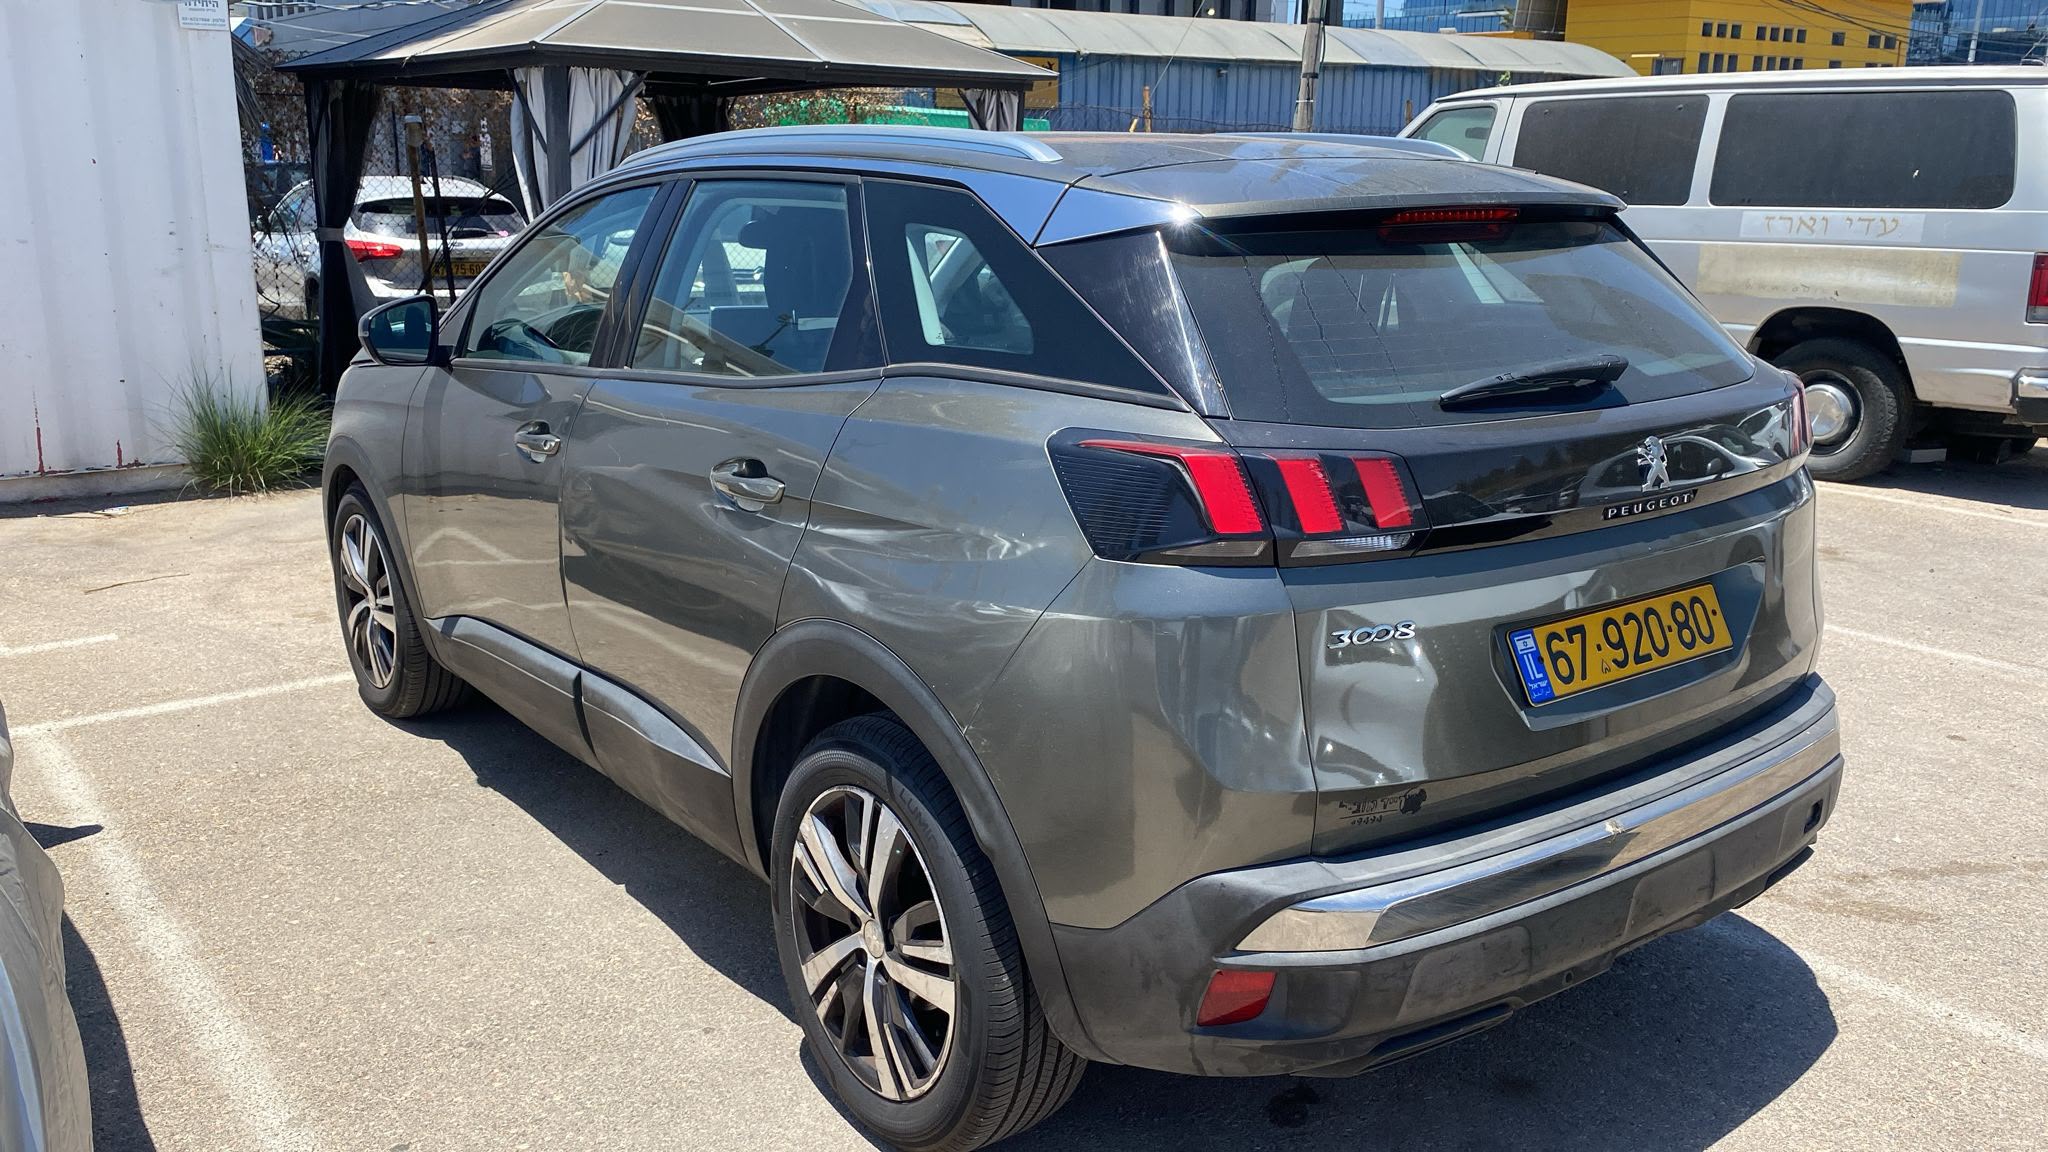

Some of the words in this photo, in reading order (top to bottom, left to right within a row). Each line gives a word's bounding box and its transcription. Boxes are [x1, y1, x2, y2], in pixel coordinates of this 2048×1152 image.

[1764, 215, 1829, 235] וארז
[1844, 215, 1899, 237] עדי
[1608, 493, 1691, 519] PEUGEOT
[1327, 619, 1416, 649] 3008
[1523, 652, 1543, 680] IL
